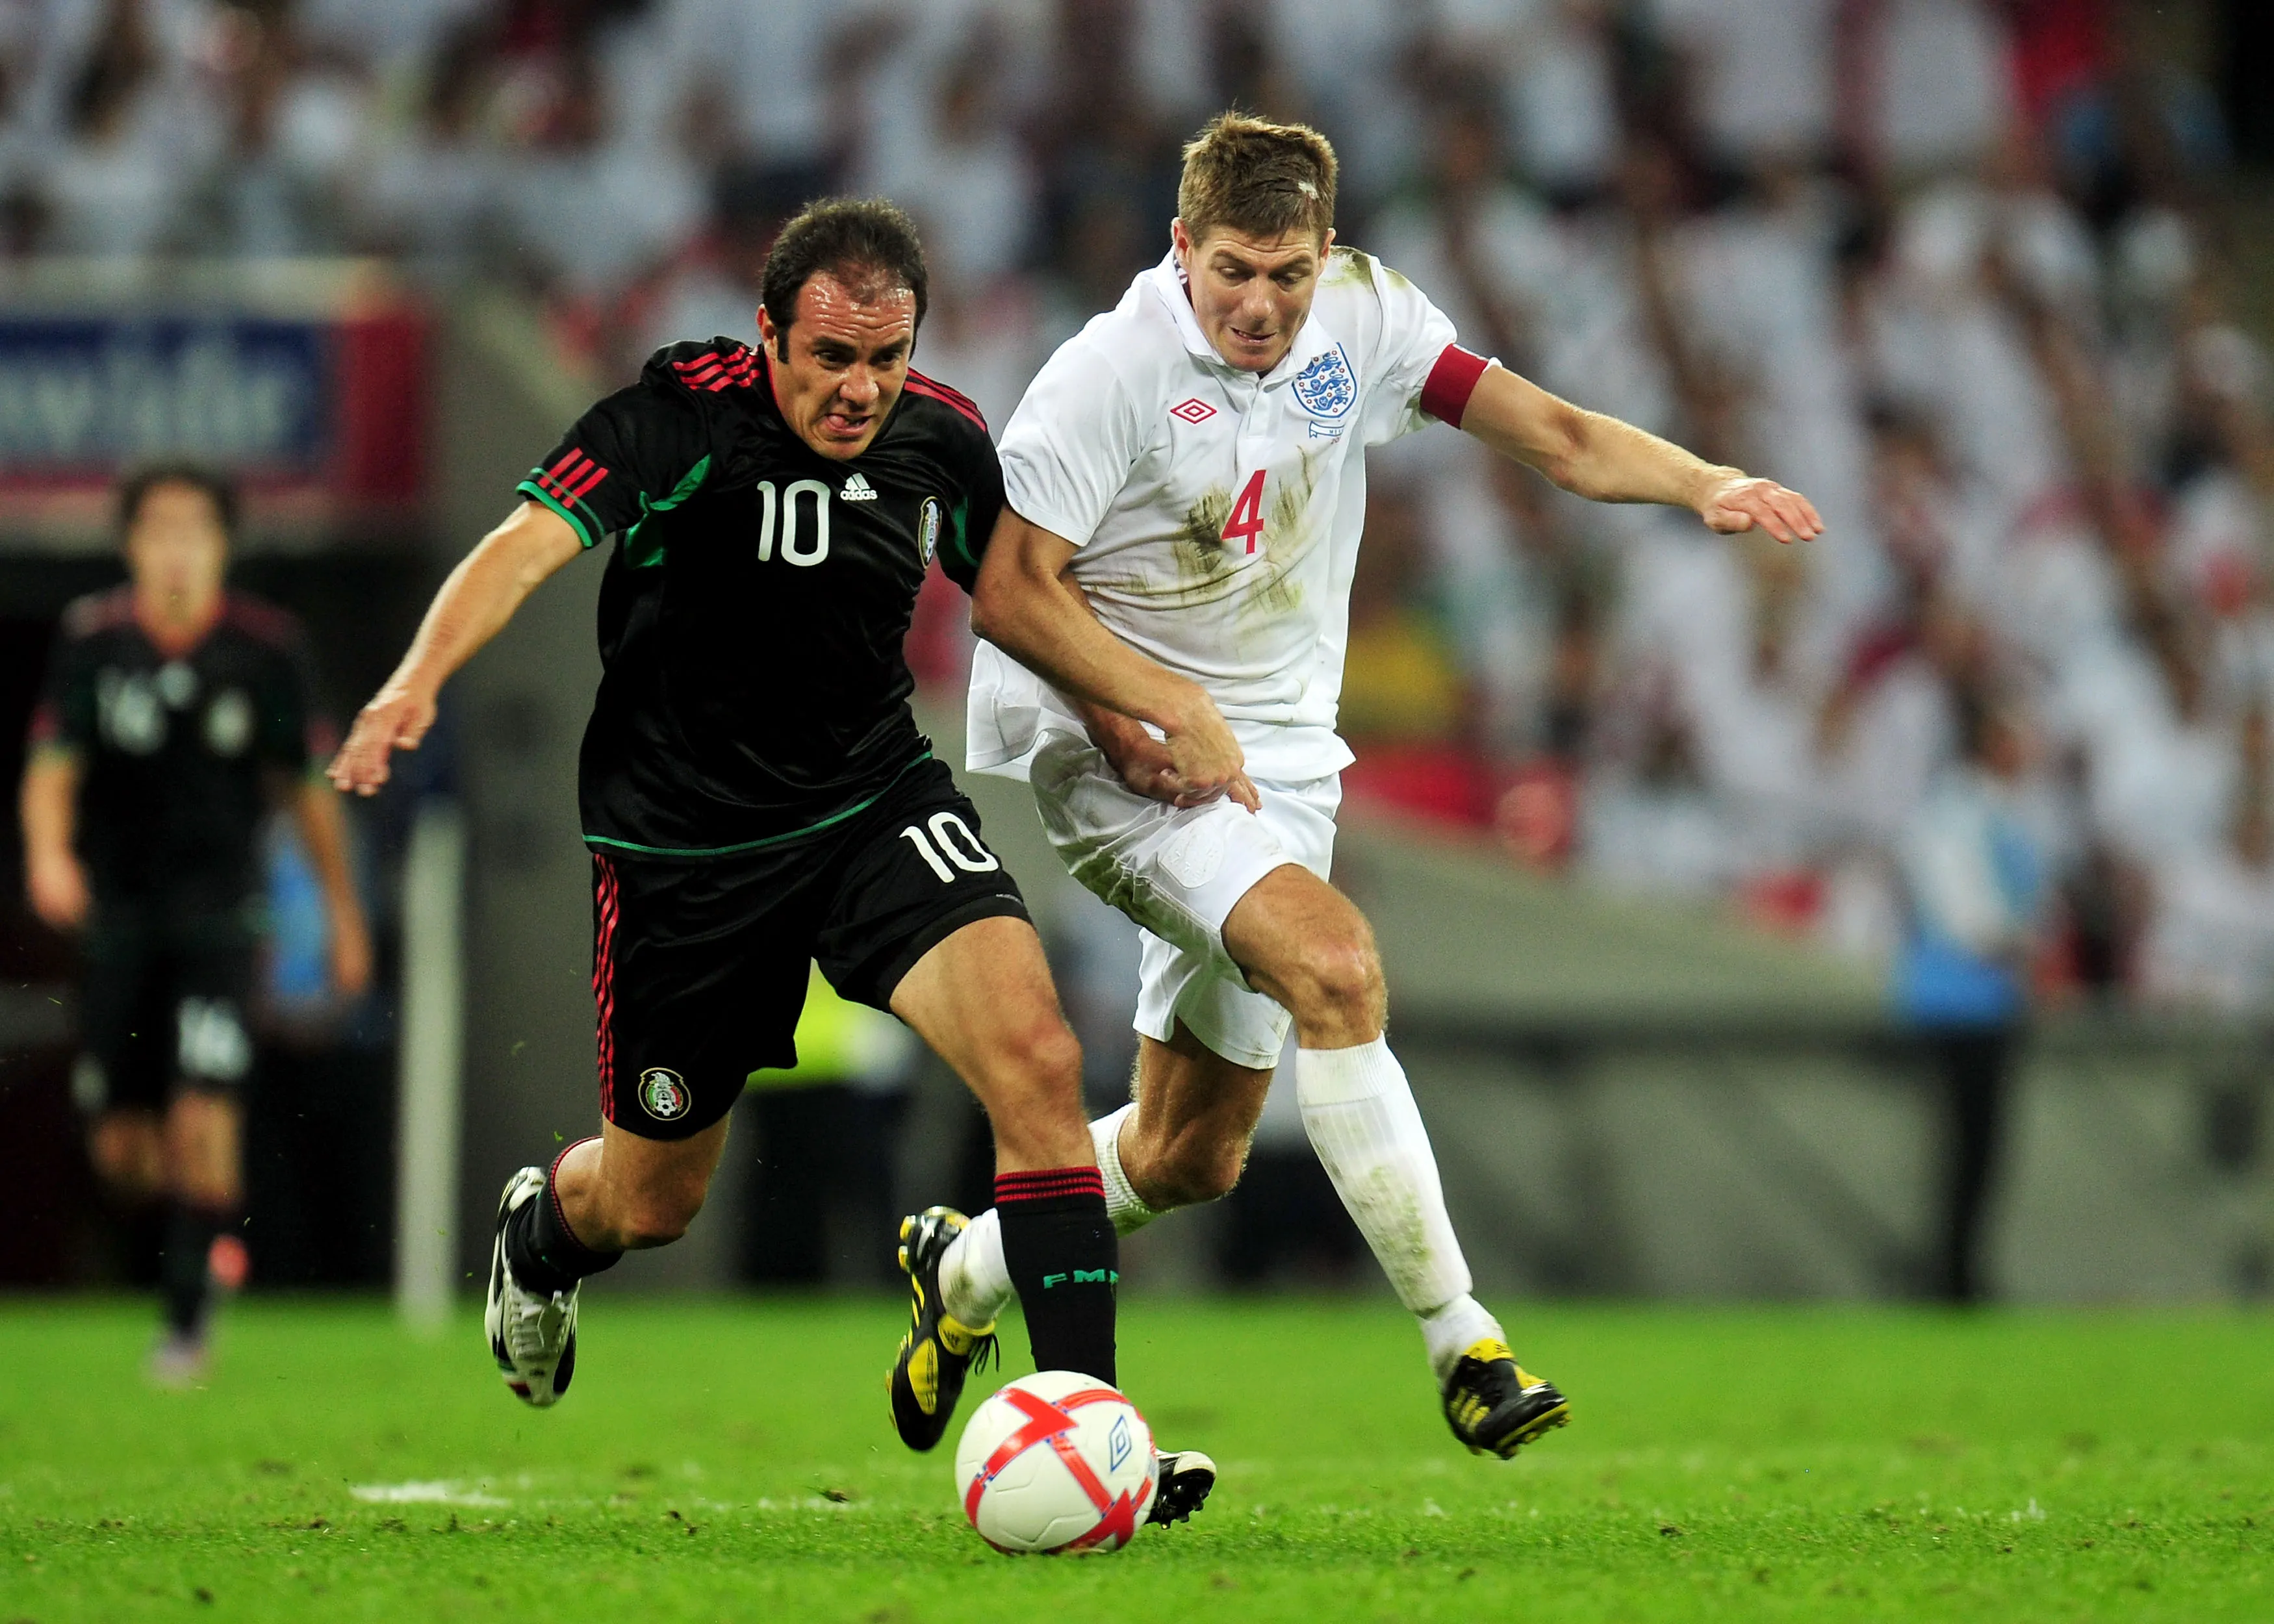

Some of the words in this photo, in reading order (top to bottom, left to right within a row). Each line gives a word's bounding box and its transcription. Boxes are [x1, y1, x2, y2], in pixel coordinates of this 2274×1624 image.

[756, 479, 832, 566] 10
[1221, 469, 1267, 555] 4
[899, 811, 999, 883] 10
